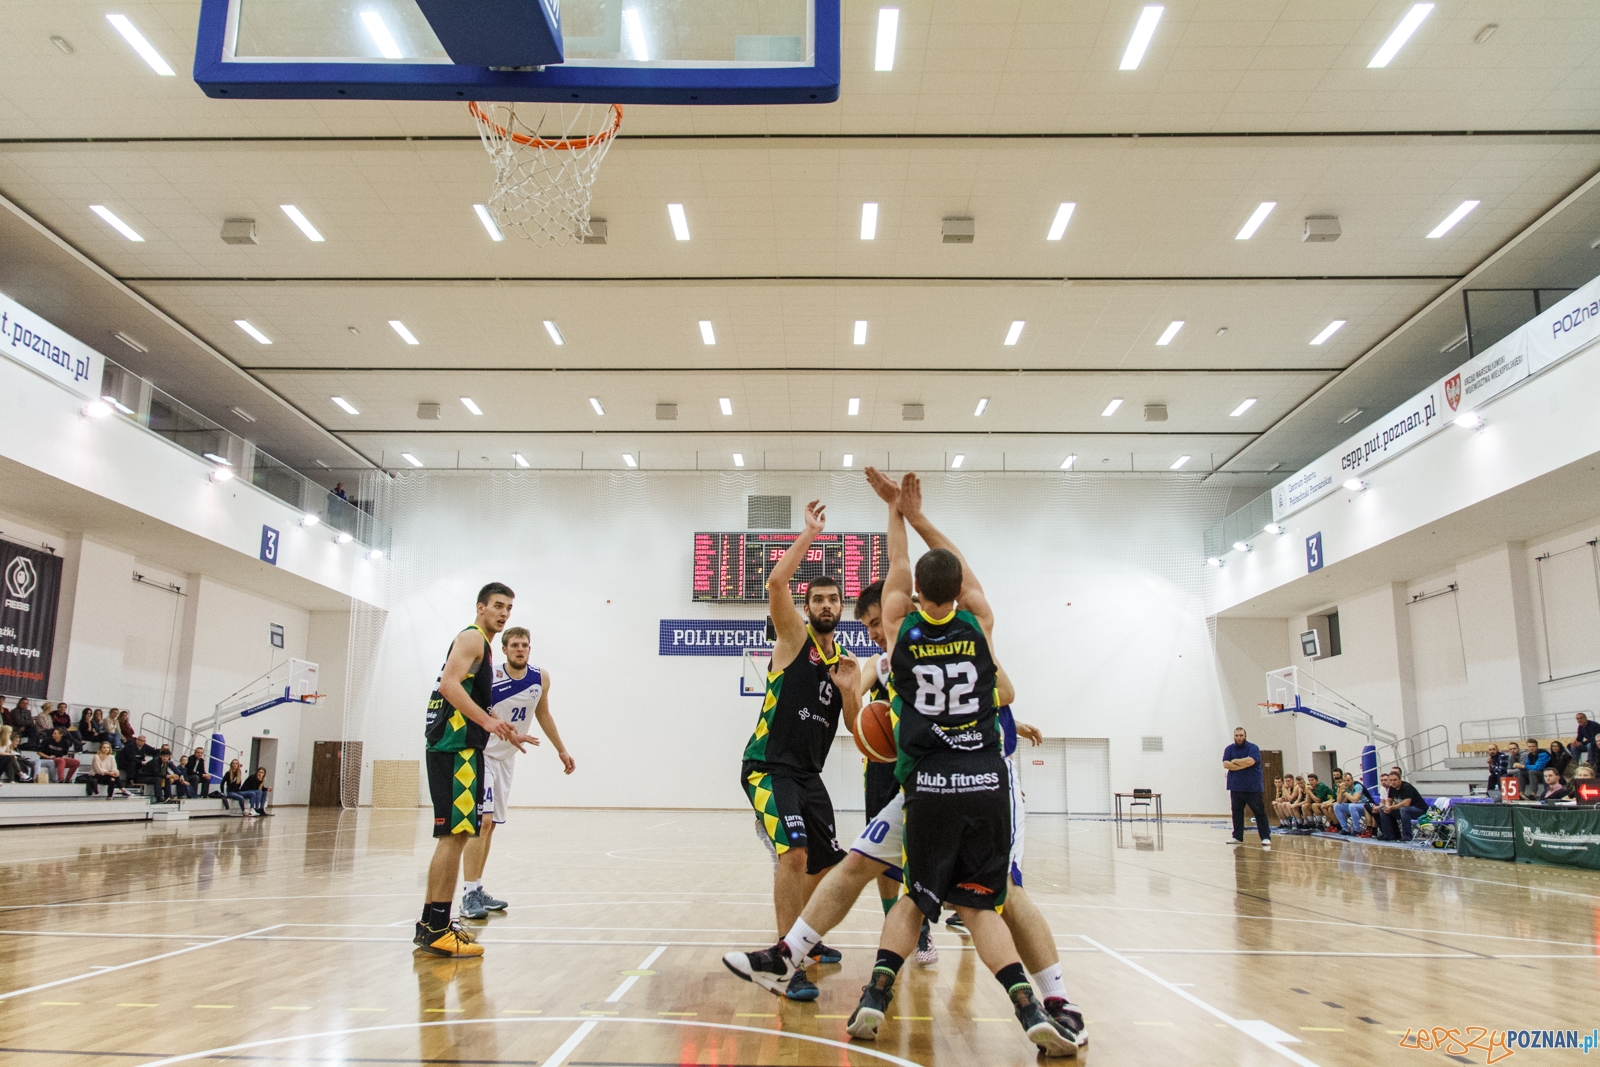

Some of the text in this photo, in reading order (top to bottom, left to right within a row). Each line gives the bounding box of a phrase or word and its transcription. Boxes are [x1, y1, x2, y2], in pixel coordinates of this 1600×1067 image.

[1552, 299, 1600, 339] POZna
[0, 311, 91, 381] t.poznan.pl
[1341, 394, 1437, 470] cspp.put.poznan.pl
[265, 530, 276, 560] 3
[770, 549, 787, 561] 39
[806, 549, 823, 561] 30
[1308, 537, 1320, 567] 3
[5, 598, 30, 612] REBIS
[672, 629, 776, 646] POLITECHN
[20, 647, 41, 659] czyta
[908, 640, 977, 660] TARNOVIA
[911, 661, 980, 716] 82
[510, 706, 527, 723] 24
[916, 771, 999, 787] klub fitness
[860, 818, 890, 844] 10
